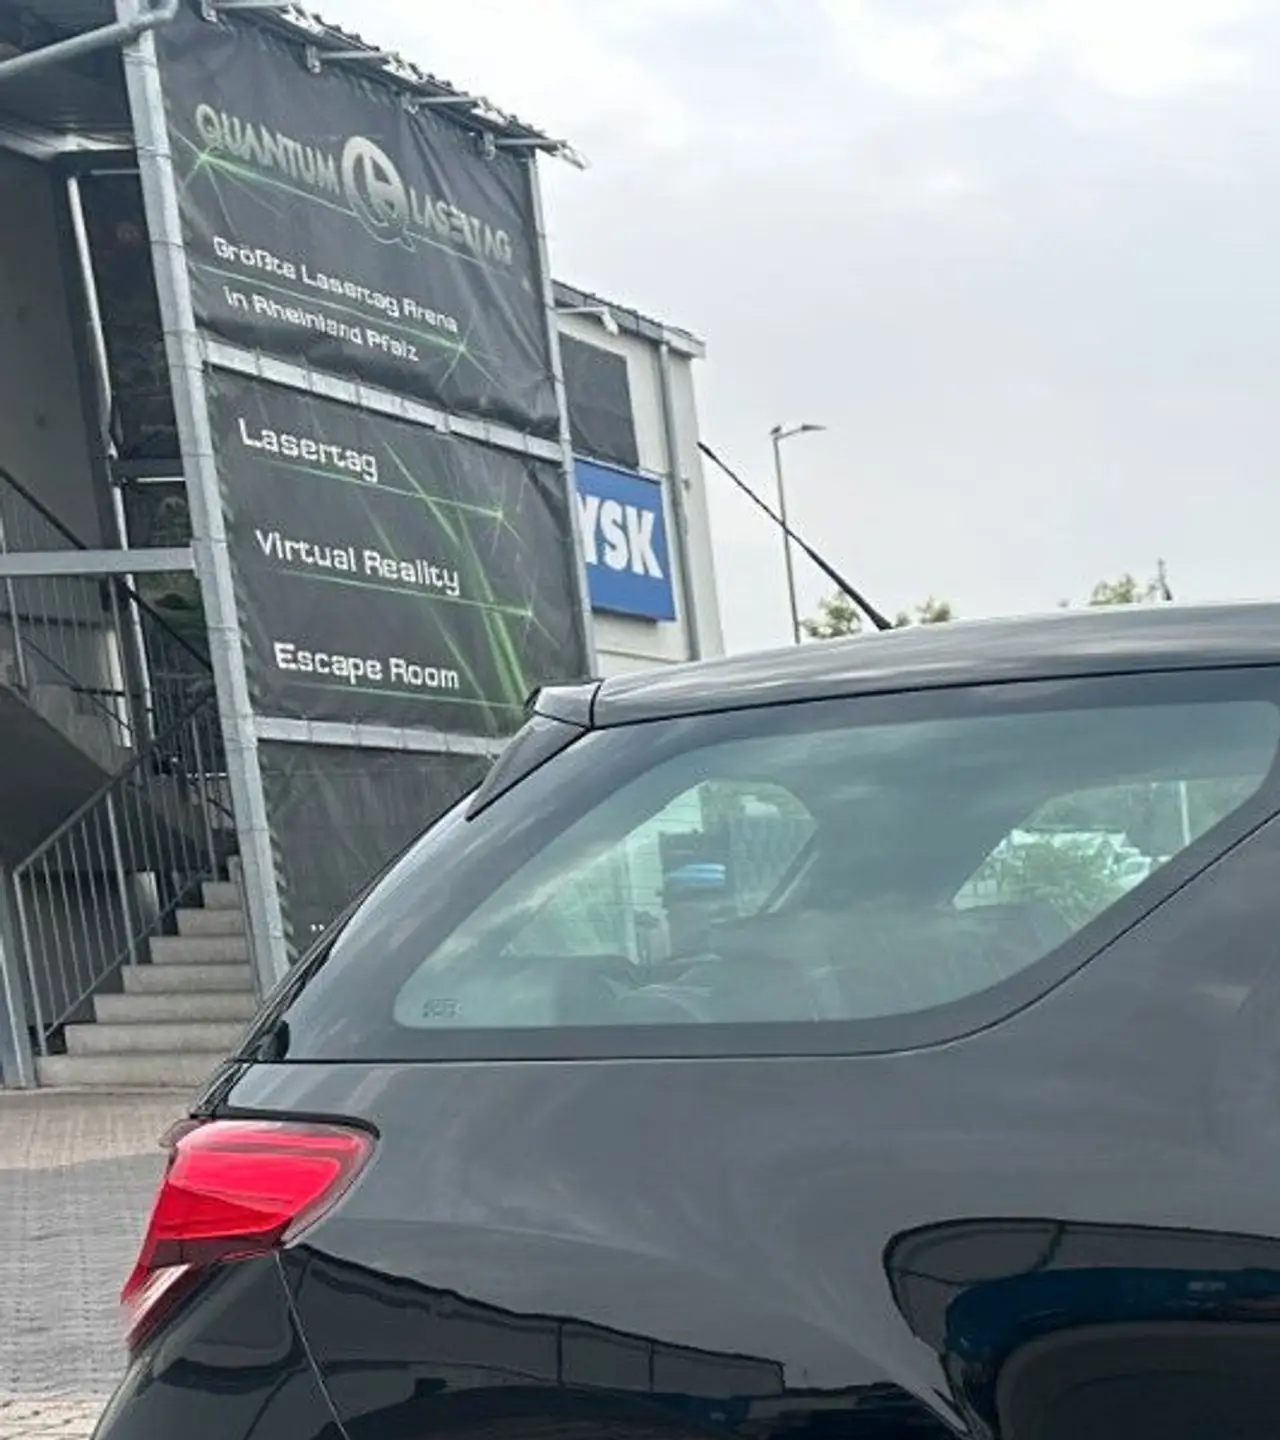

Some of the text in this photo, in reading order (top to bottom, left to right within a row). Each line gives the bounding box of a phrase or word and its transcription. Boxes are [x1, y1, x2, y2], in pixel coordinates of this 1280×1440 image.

[196, 103, 513, 265] QUANTUM LASERTAG
[213, 235, 459, 334] Größte Lasertag Arena
[252, 294, 363, 345] Rheinland
[366, 329, 420, 362] Pfalz
[238, 418, 378, 483] Lasertag
[255, 530, 460, 596] Virtual Reality
[273, 641, 460, 690] Escape Room
